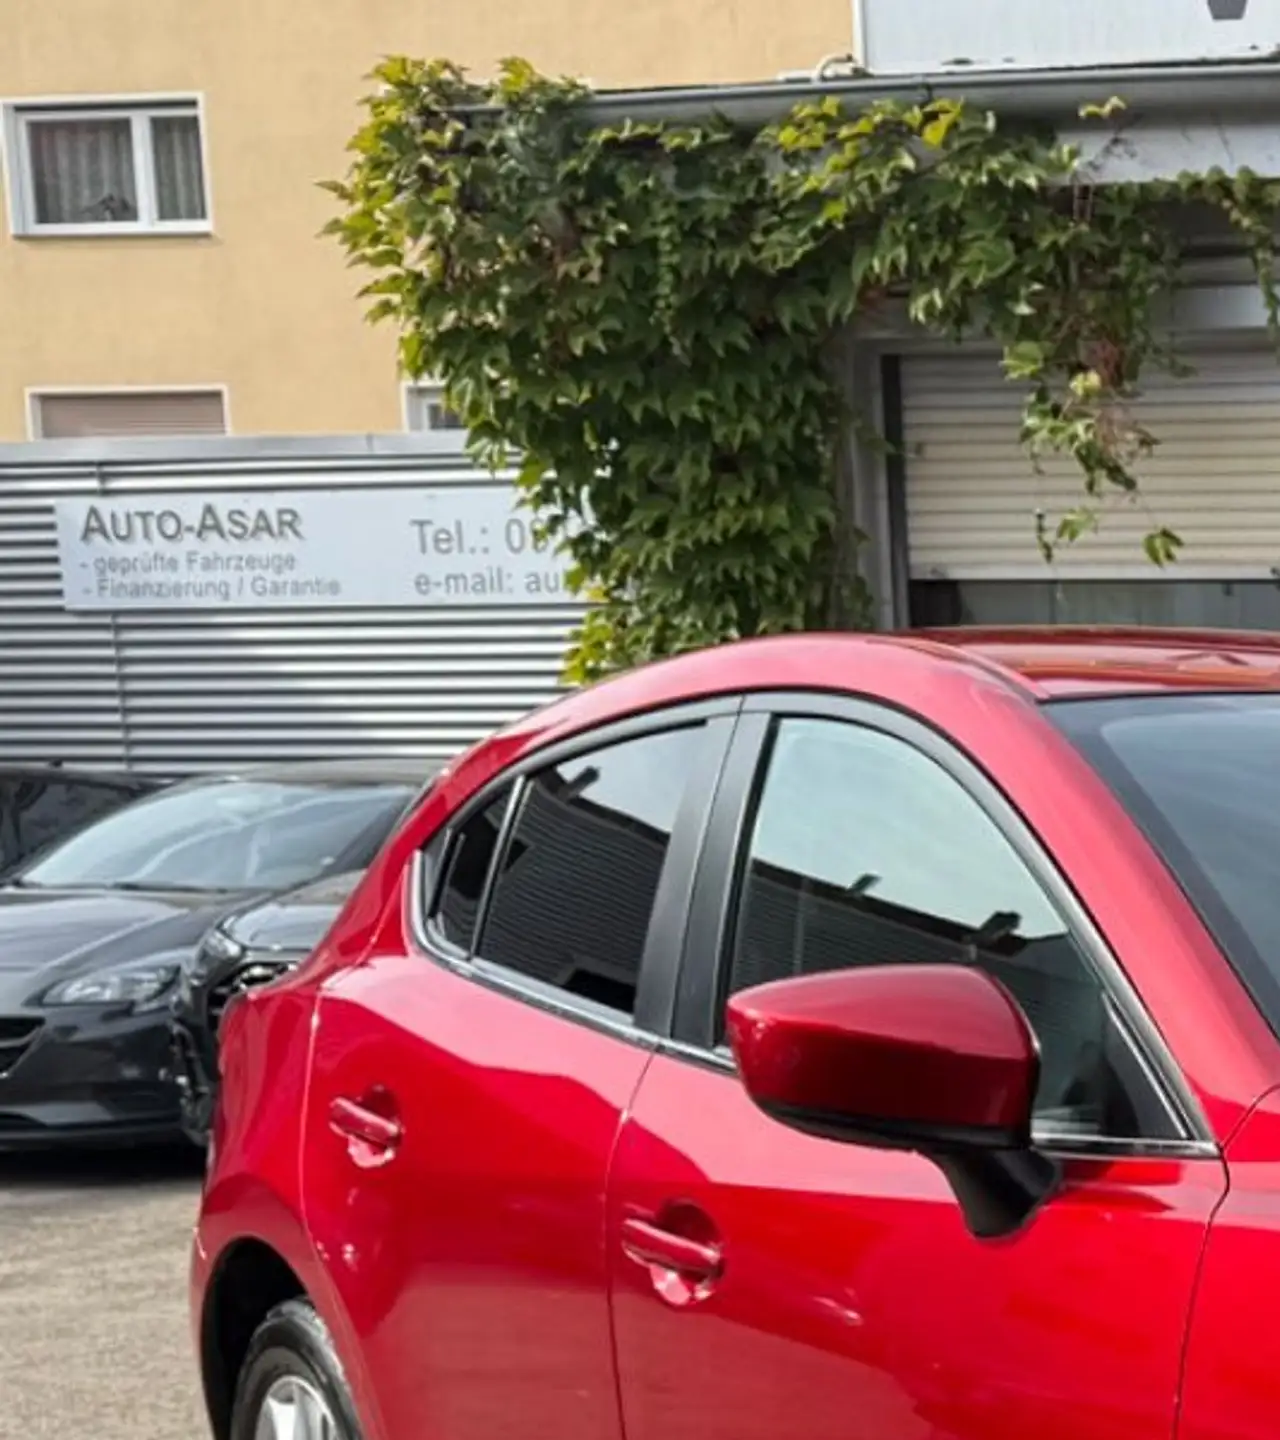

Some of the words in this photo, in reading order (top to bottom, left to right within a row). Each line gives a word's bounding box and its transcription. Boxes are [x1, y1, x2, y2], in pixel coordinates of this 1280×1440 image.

[409, 519, 490, 555] Tel.:
[93, 551, 178, 575] geprüfte
[186, 549, 296, 573] Fahrzeuge
[96, 578, 231, 600] Finanzierung
[250, 575, 342, 597] Garantie
[414, 567, 514, 596] e-mail:
[525, 571, 563, 594] au
